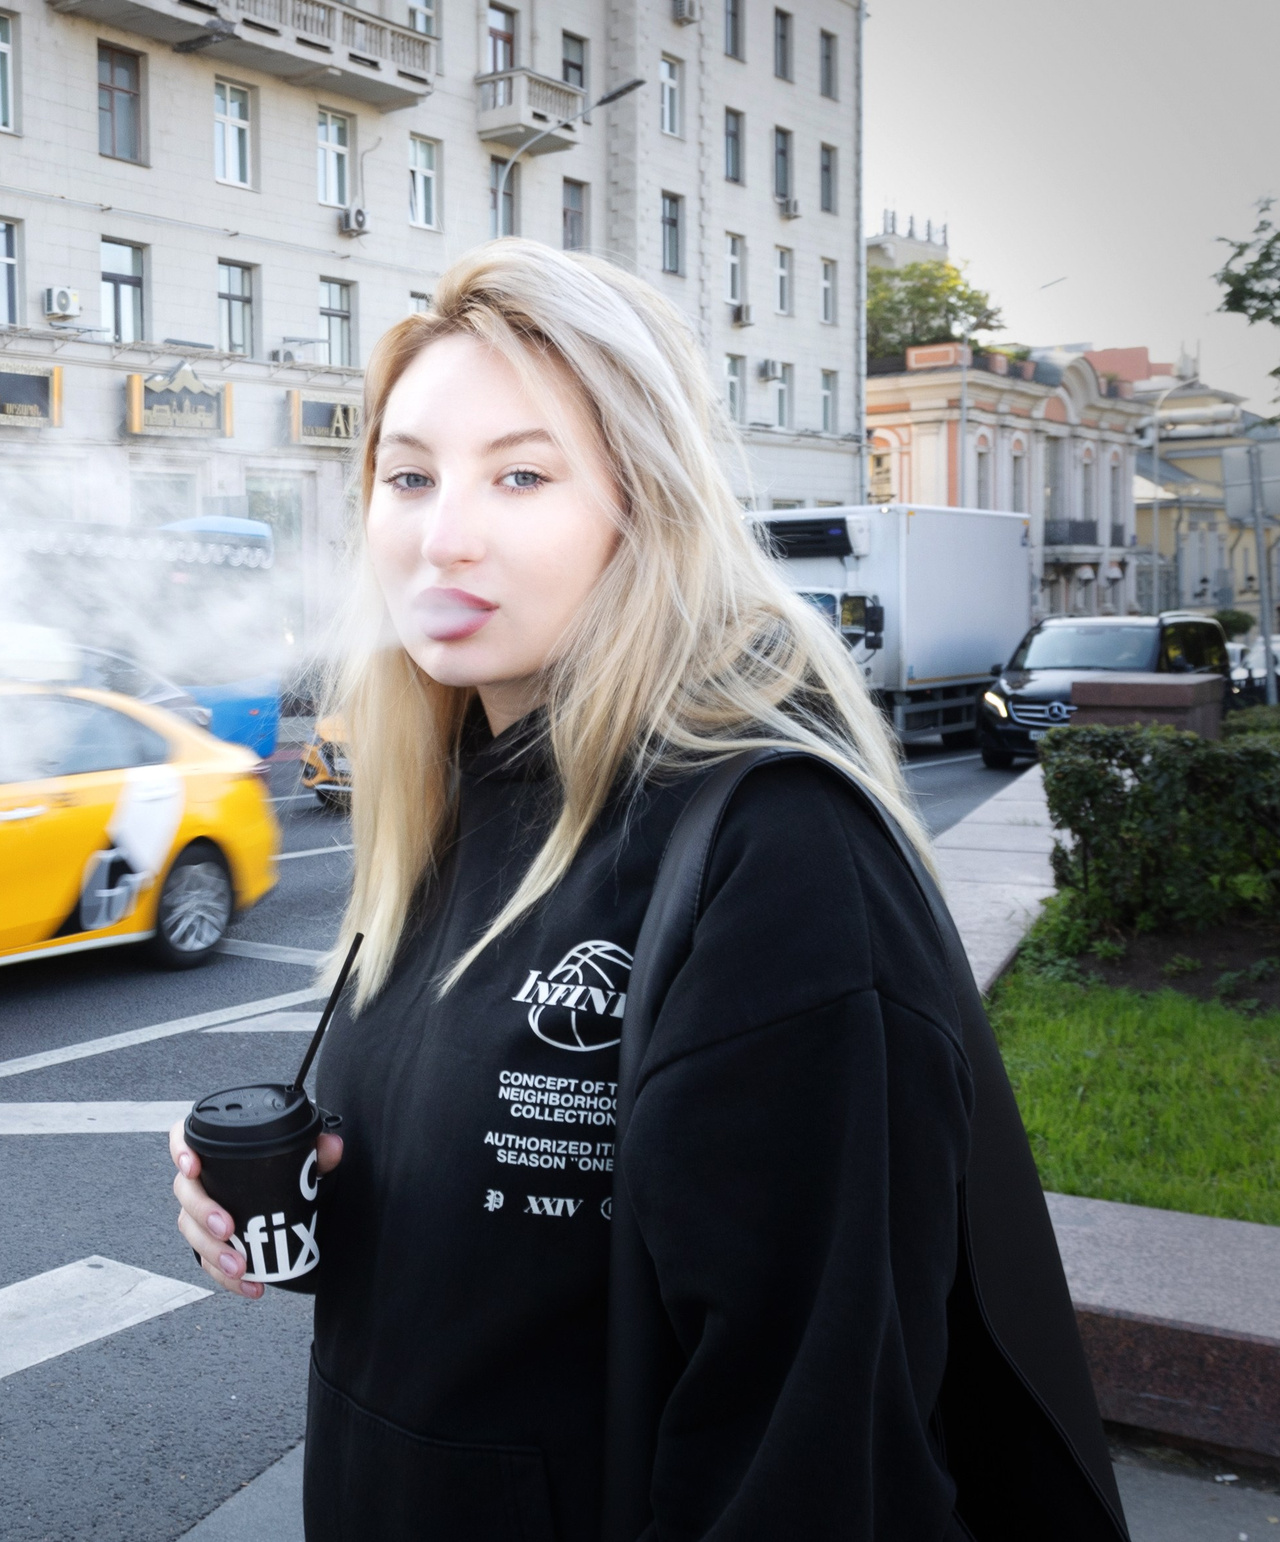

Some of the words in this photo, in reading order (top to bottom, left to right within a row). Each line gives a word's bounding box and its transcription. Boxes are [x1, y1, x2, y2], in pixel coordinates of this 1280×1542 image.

[499, 1070, 579, 1093] CONCEPT
[581, 1080, 605, 1095] OF
[510, 1103, 617, 1126] COLLECTION
[484, 1131, 592, 1156] AUTHORIZED
[596, 1142, 615, 1156] IT
[496, 1149, 566, 1170] SEASON
[523, 1195, 584, 1218] XXIV
